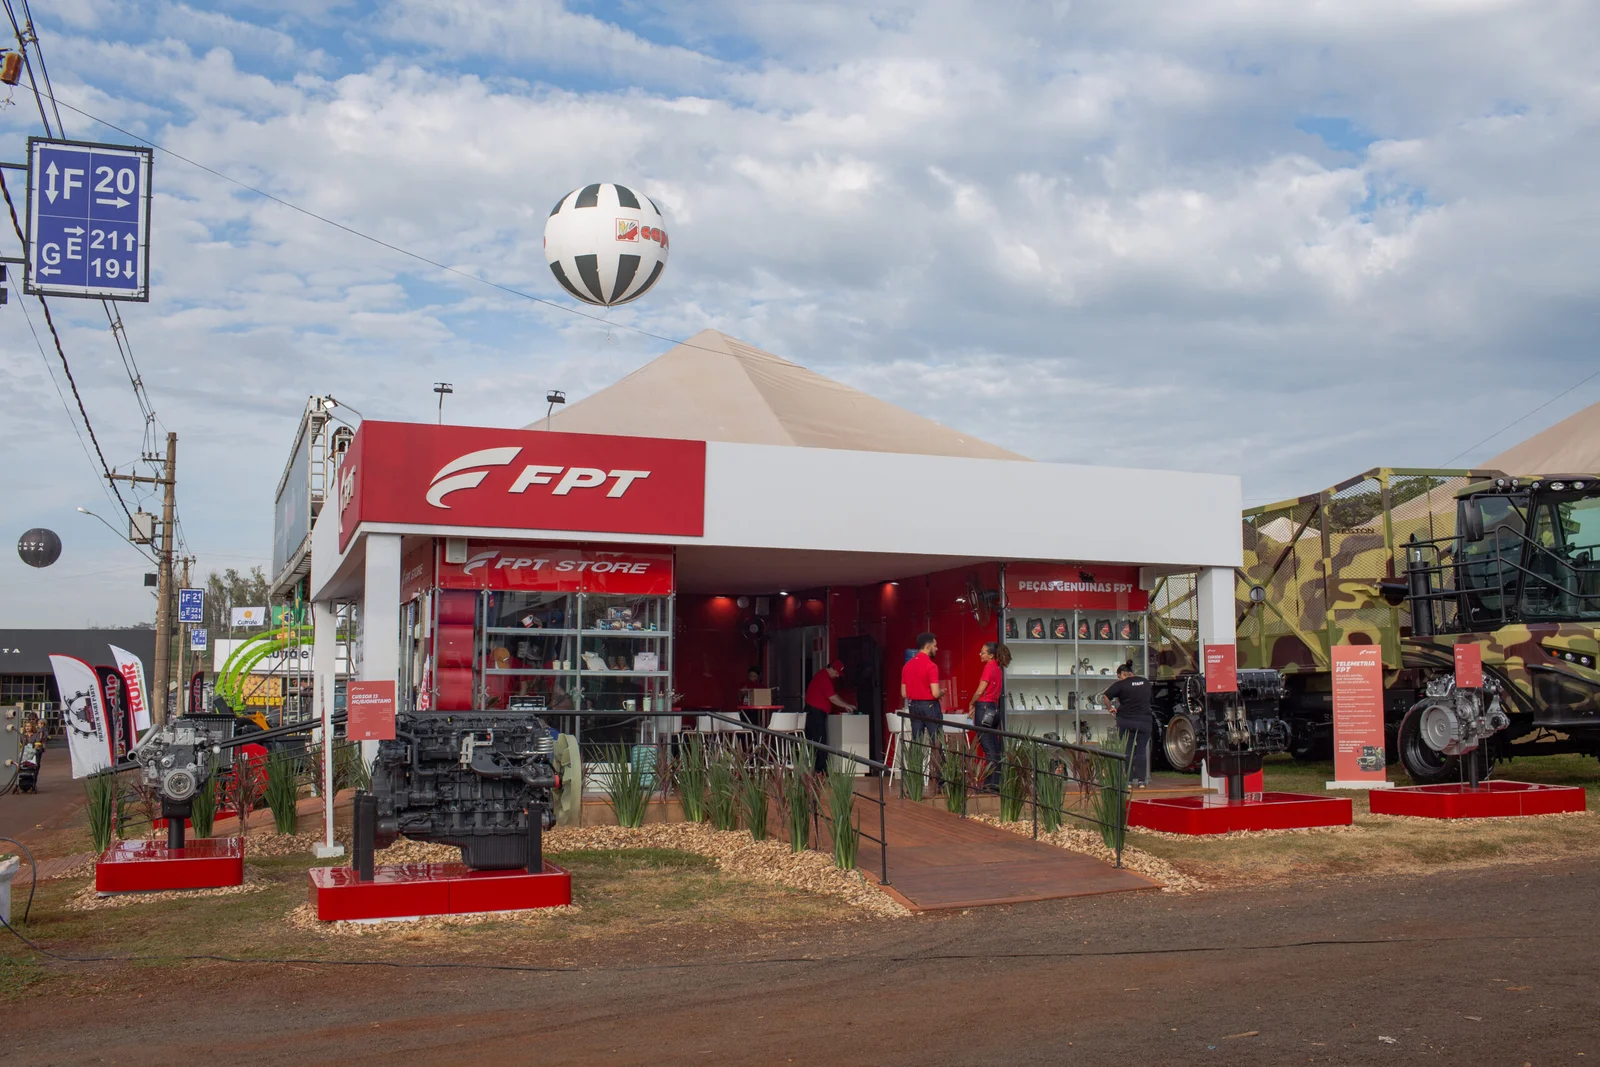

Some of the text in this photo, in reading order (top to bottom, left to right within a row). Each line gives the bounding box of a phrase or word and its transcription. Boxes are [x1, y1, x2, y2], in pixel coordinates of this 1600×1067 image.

[63, 168, 85, 200] F
[94, 166, 136, 195] 20
[66, 237, 83, 260] E
[90, 229, 118, 250] 21
[640, 225, 669, 250] cop
[41, 242, 61, 265] G
[91, 257, 120, 279] 19
[507, 464, 652, 499] FPT
[494, 557, 651, 574] FPT STORE
[185, 593, 191, 602] F
[192, 592, 202, 600] 21
[1018, 581, 1055, 593] PEÇAS
[1113, 583, 1134, 593] FPT
[193, 678, 202, 713] pello
